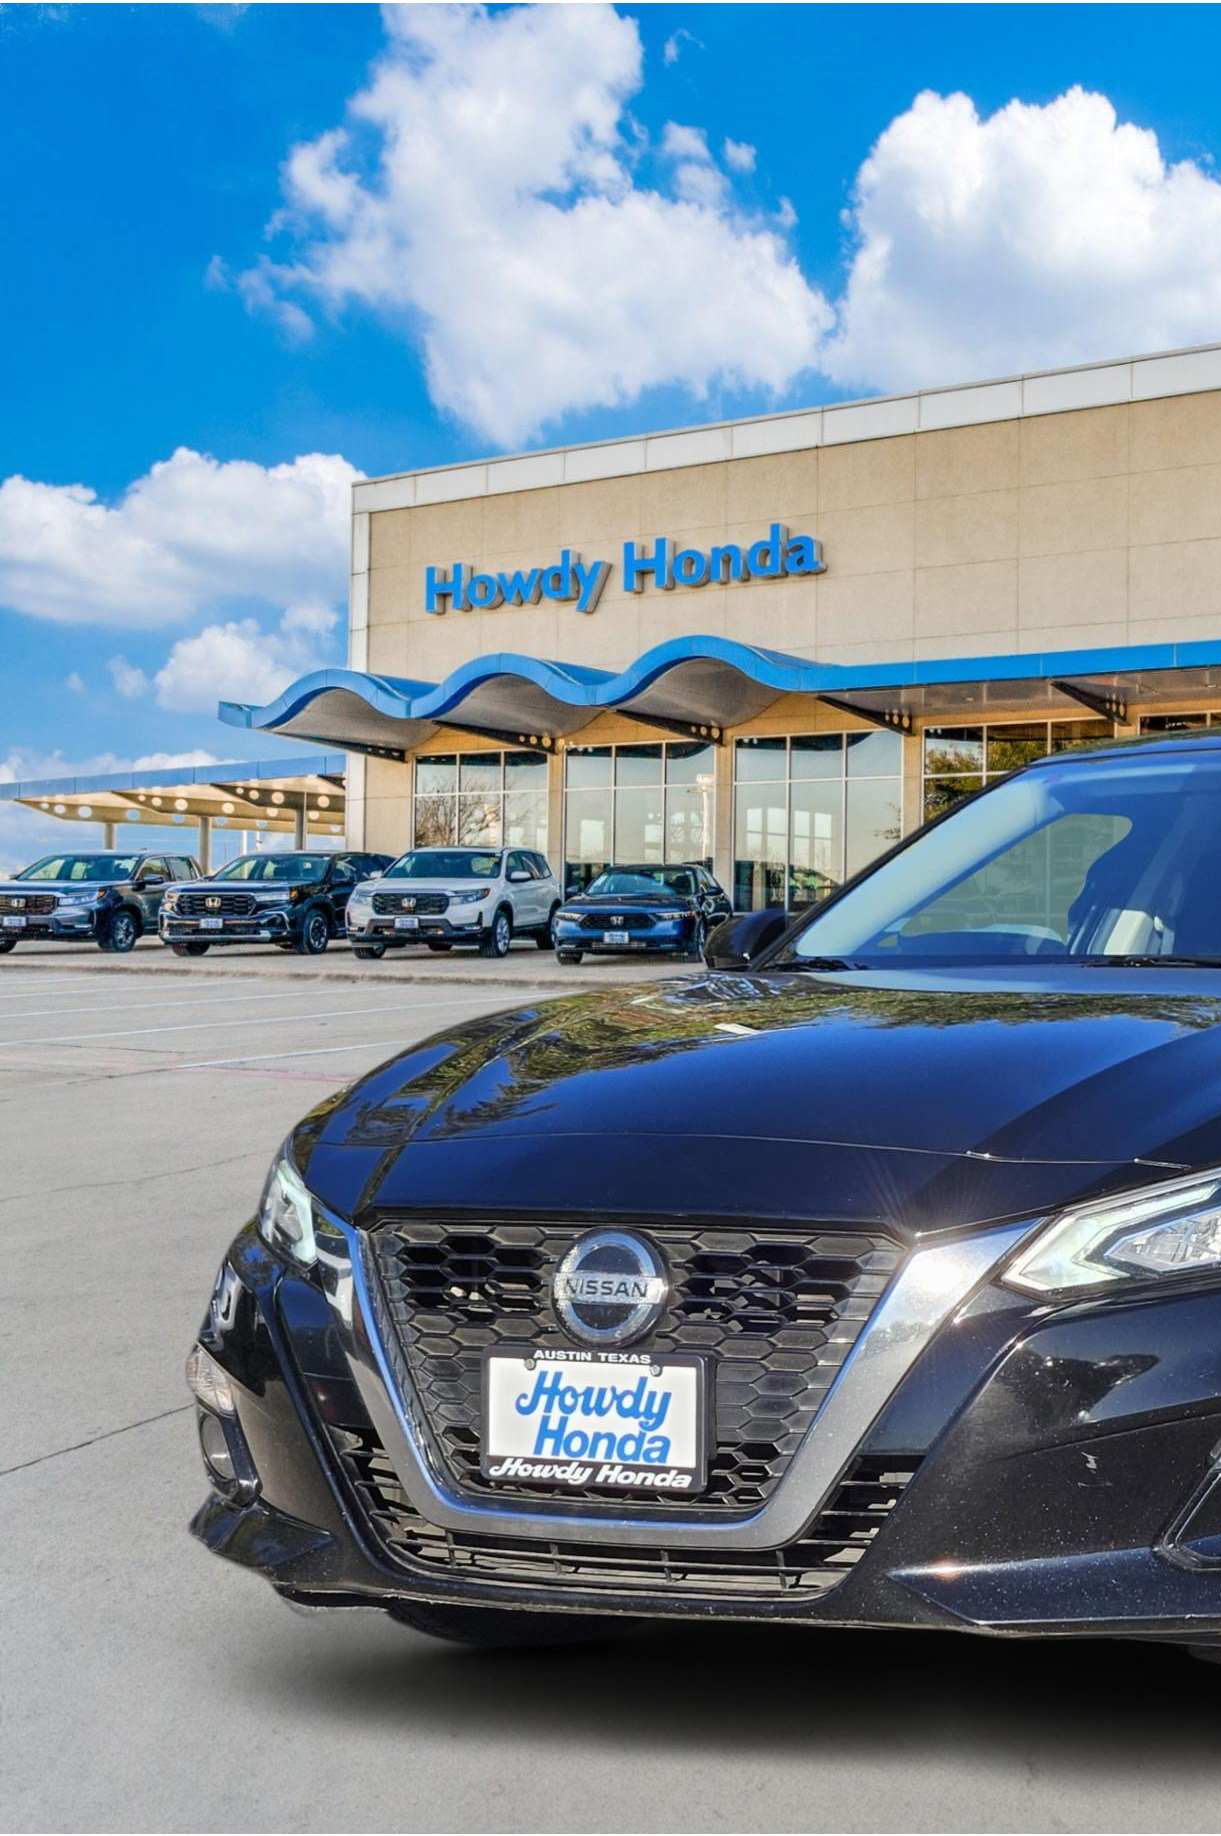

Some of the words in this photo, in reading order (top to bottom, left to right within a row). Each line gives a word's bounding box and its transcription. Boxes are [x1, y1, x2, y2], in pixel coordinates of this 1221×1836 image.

[425, 549, 611, 614] Howdy
[623, 523, 827, 593] Honda
[564, 1279, 648, 1298] NISSAN
[533, 1350, 592, 1361] AUSTIN
[598, 1352, 651, 1364] TEXAS
[515, 1370, 672, 1431] Howdy
[533, 1415, 671, 1463] Honda
[489, 1458, 594, 1483] Howdy
[596, 1464, 692, 1488] Honda
